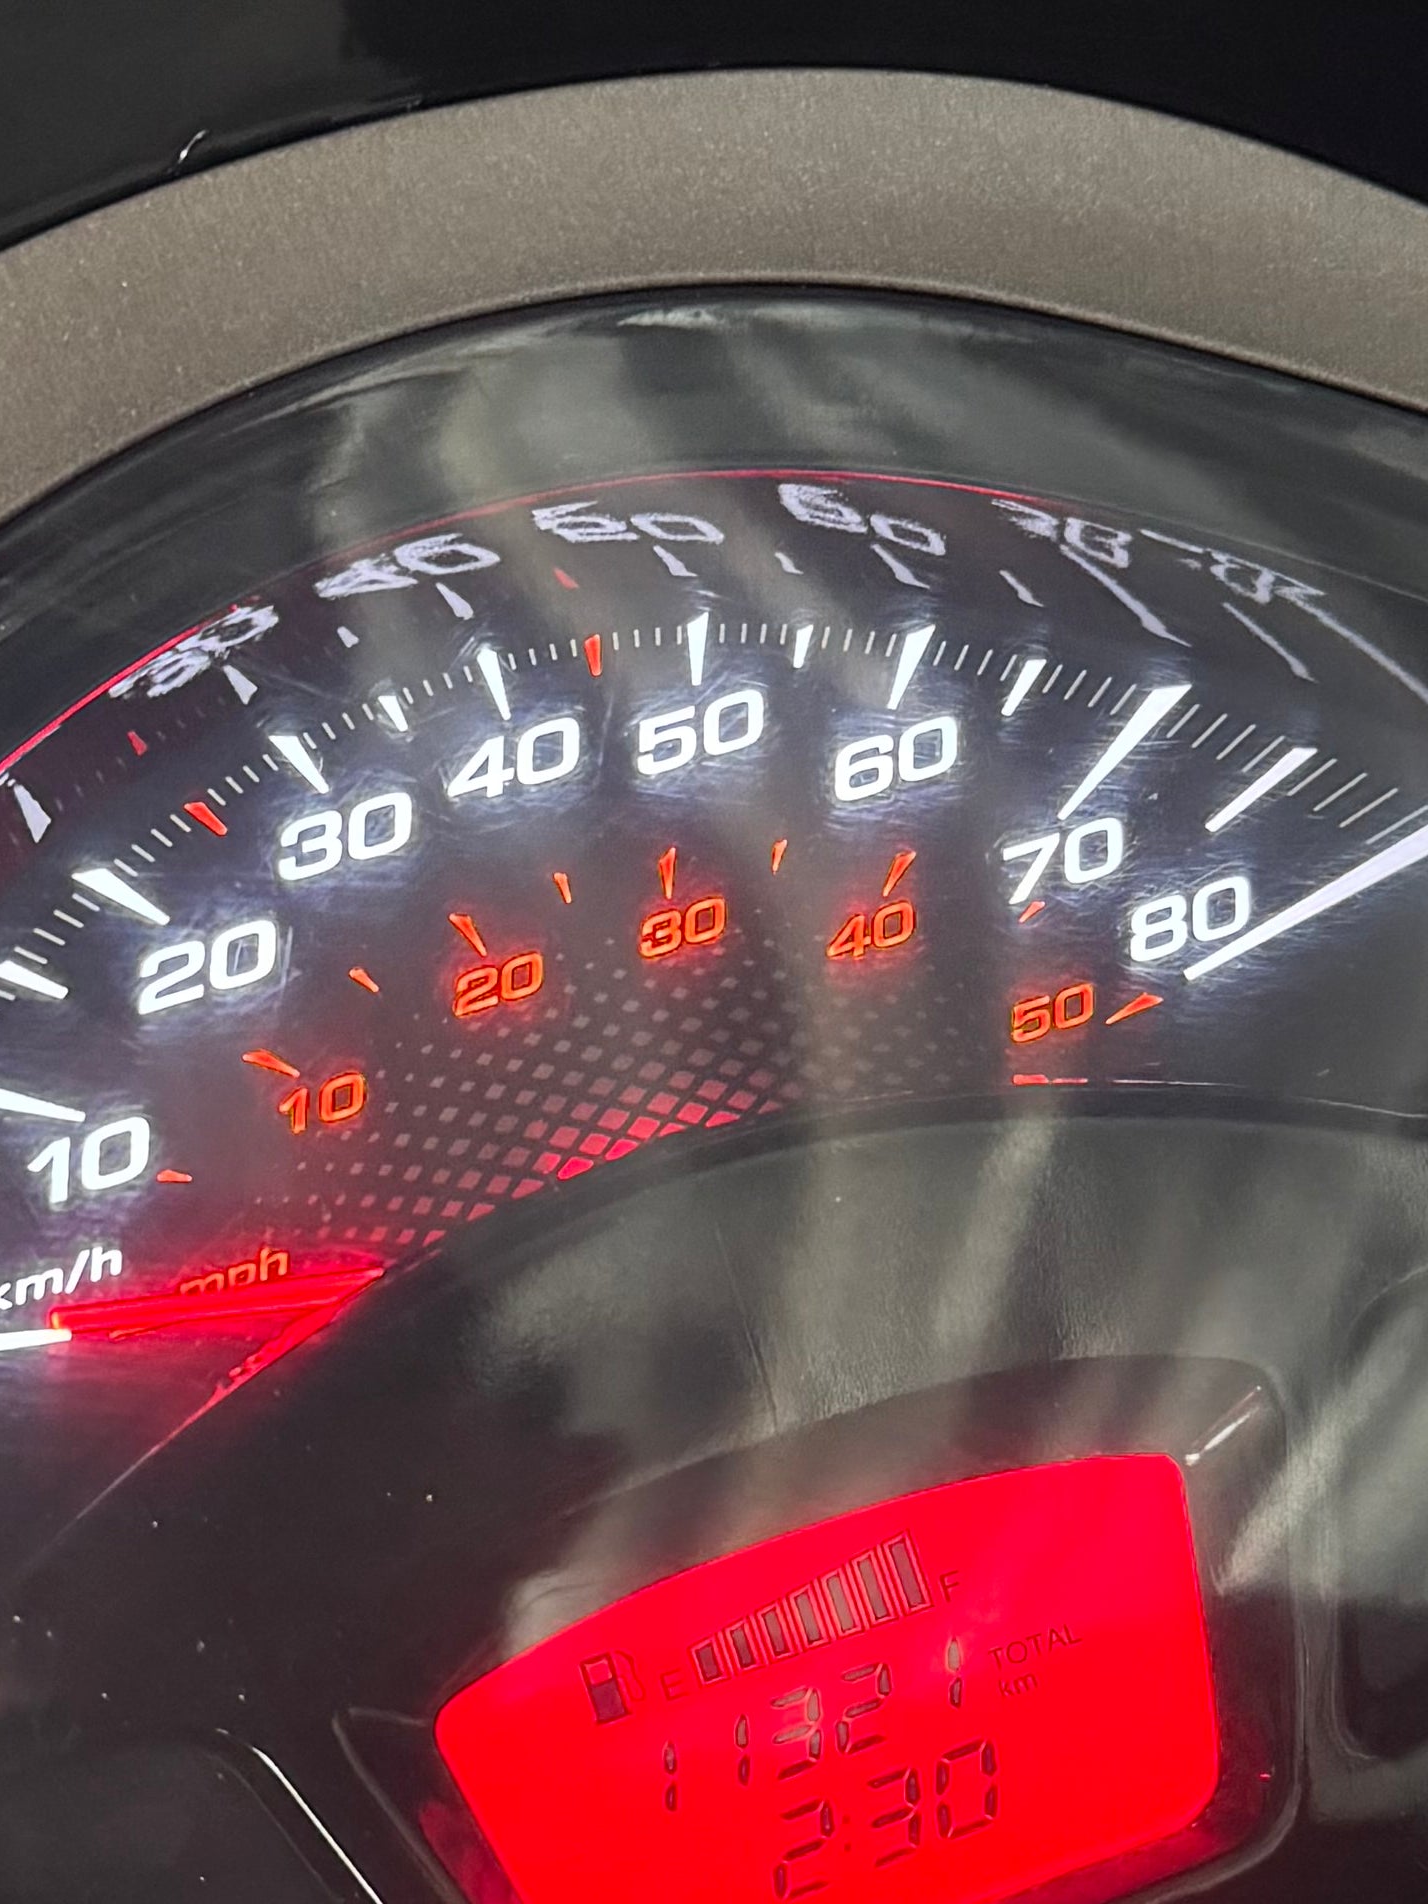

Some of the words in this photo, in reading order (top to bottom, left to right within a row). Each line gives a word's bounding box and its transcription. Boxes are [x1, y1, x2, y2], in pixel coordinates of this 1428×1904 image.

[446, 717, 580, 798] 40
[636, 689, 766, 778] 50
[833, 716, 959, 802] 60
[277, 792, 413, 882] 30
[1001, 817, 1125, 906] 70
[638, 896, 727, 959] 30
[826, 901, 916, 959] 40
[1129, 876, 1252, 962] 80
[137, 919, 278, 1015] 20
[452, 951, 544, 1018] 20
[1010, 983, 1094, 1045] 50
[278, 1070, 367, 1134] 10
[27, 1116, 151, 1204] 10
[939, 1570, 962, 1602] F
[659, 1668, 687, 1702] E
[988, 1623, 1083, 1673] TOTAL
[997, 1672, 1040, 1697] km
[773, 1739, 999, 1901] 2:30
